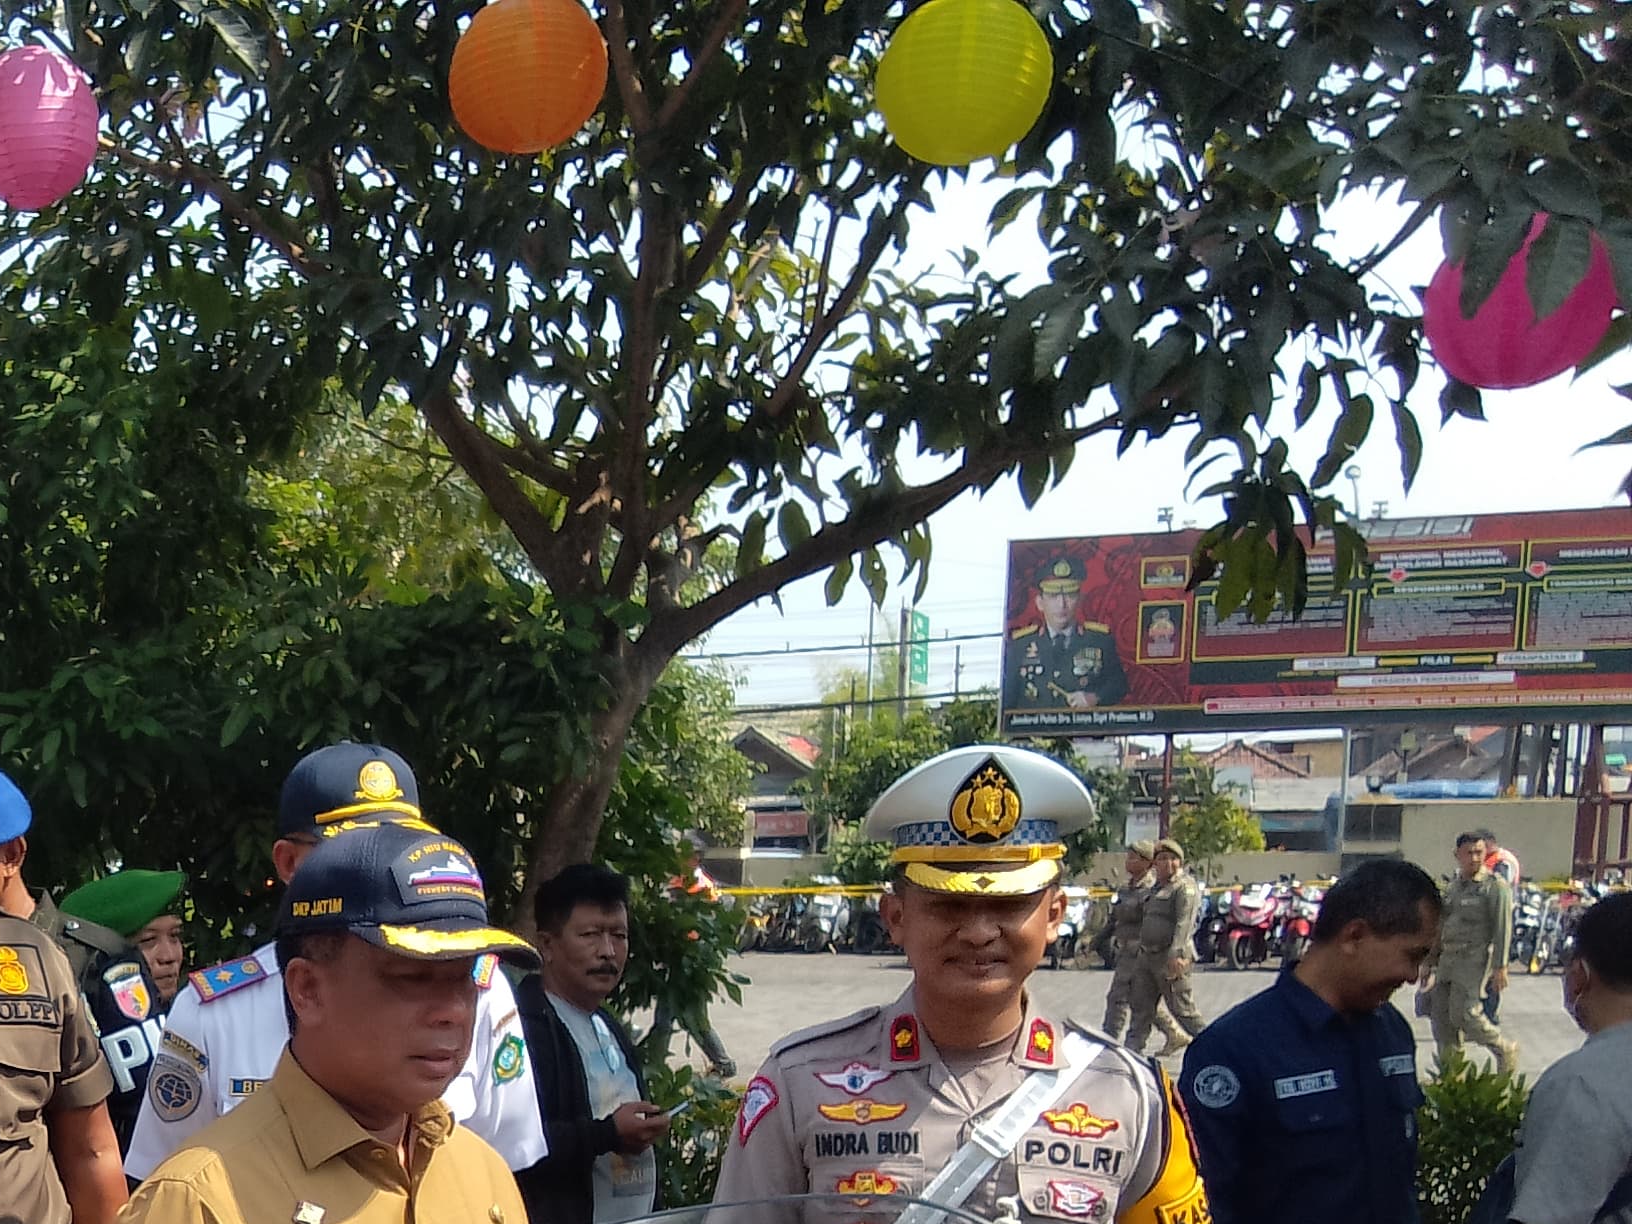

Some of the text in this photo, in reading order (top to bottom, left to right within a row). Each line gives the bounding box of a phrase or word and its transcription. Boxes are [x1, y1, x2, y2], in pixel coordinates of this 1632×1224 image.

[815, 1130, 920, 1157] INDRA BUDI
[1025, 1139, 1125, 1176] POLRI
